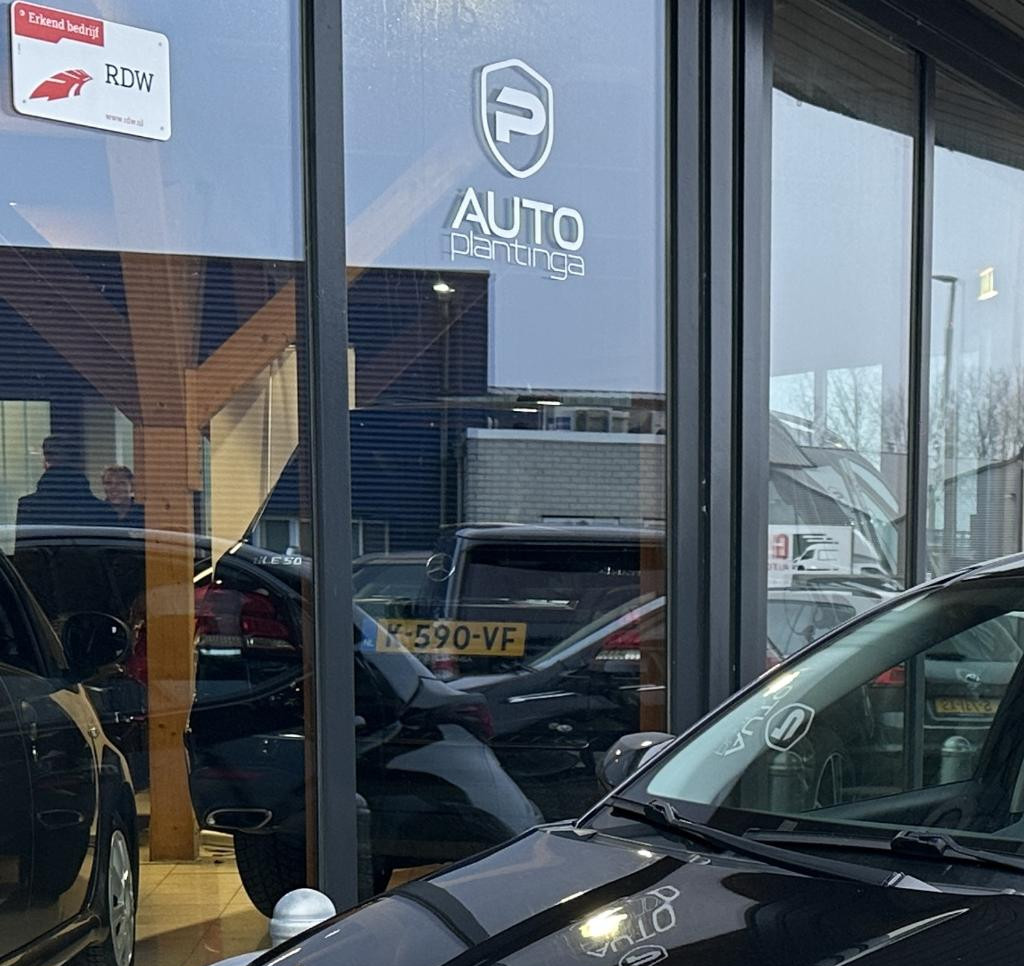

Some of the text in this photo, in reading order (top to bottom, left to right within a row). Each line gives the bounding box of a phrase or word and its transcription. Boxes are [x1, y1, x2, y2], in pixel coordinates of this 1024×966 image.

[28, 11, 100, 40] Erkend bedrijf
[104, 63, 154, 93] RDW
[451, 186, 585, 251] AUTO
[450, 230, 585, 281] plantinga
